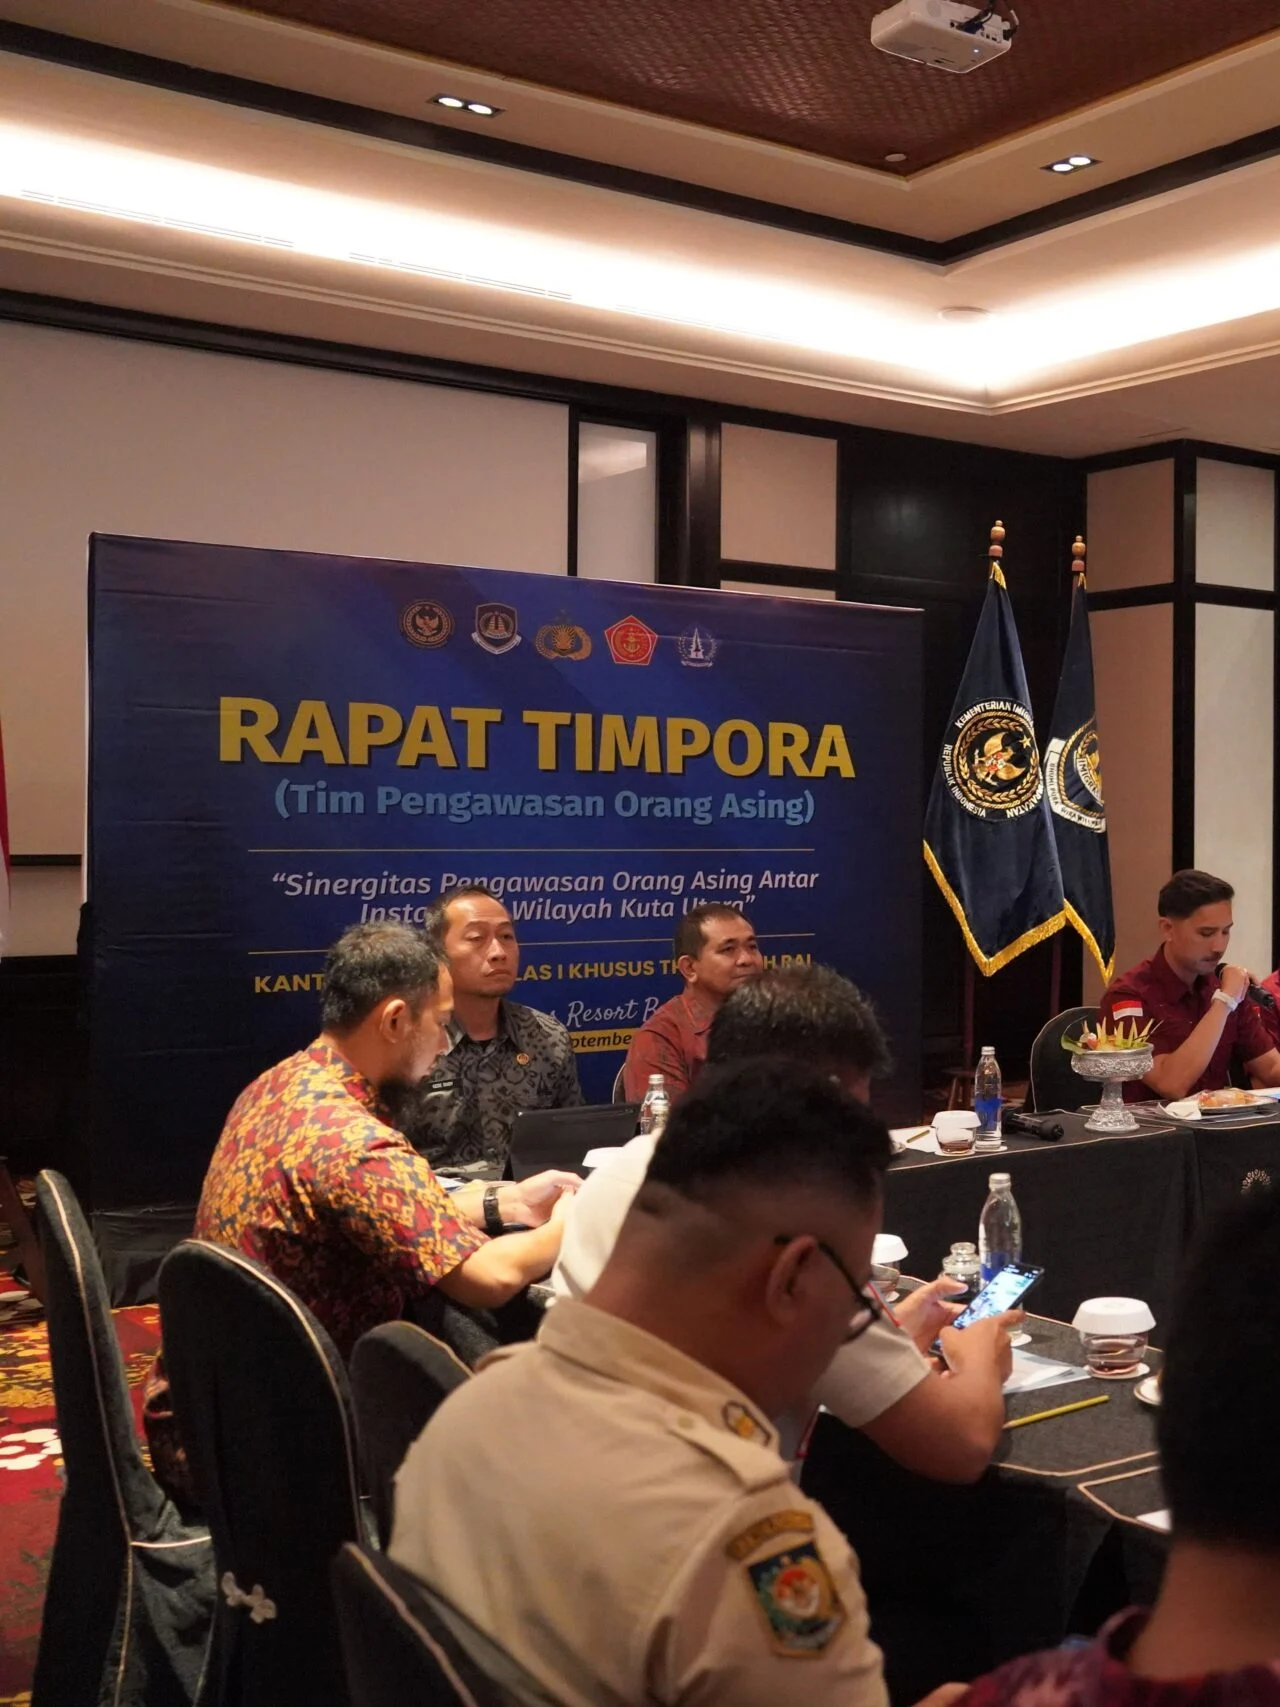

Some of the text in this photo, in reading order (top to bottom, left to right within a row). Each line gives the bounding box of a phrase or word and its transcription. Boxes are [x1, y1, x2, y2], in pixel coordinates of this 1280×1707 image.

[954, 700, 1013, 729] KEMENTERIAN
[218, 696, 857, 779] RAPAT TIMPORA
[941, 743, 954, 787] REPUBLIK
[275, 779, 816, 826] (Tim Pengawasan Orang Asing)
[950, 785, 987, 818] INDONESIA
[272, 868, 819, 900] “Sinergitas Pengawasan Orang Asing Antar
[360, 903, 428, 924] Insta
[512, 898, 612, 925] Wilayah
[620, 898, 674, 918] Kuta
[254, 973, 326, 994] KANT
[569, 960, 658, 979] KHUSUS
[566, 998, 640, 1027] Resort
[569, 1031, 633, 1049] ptembe
